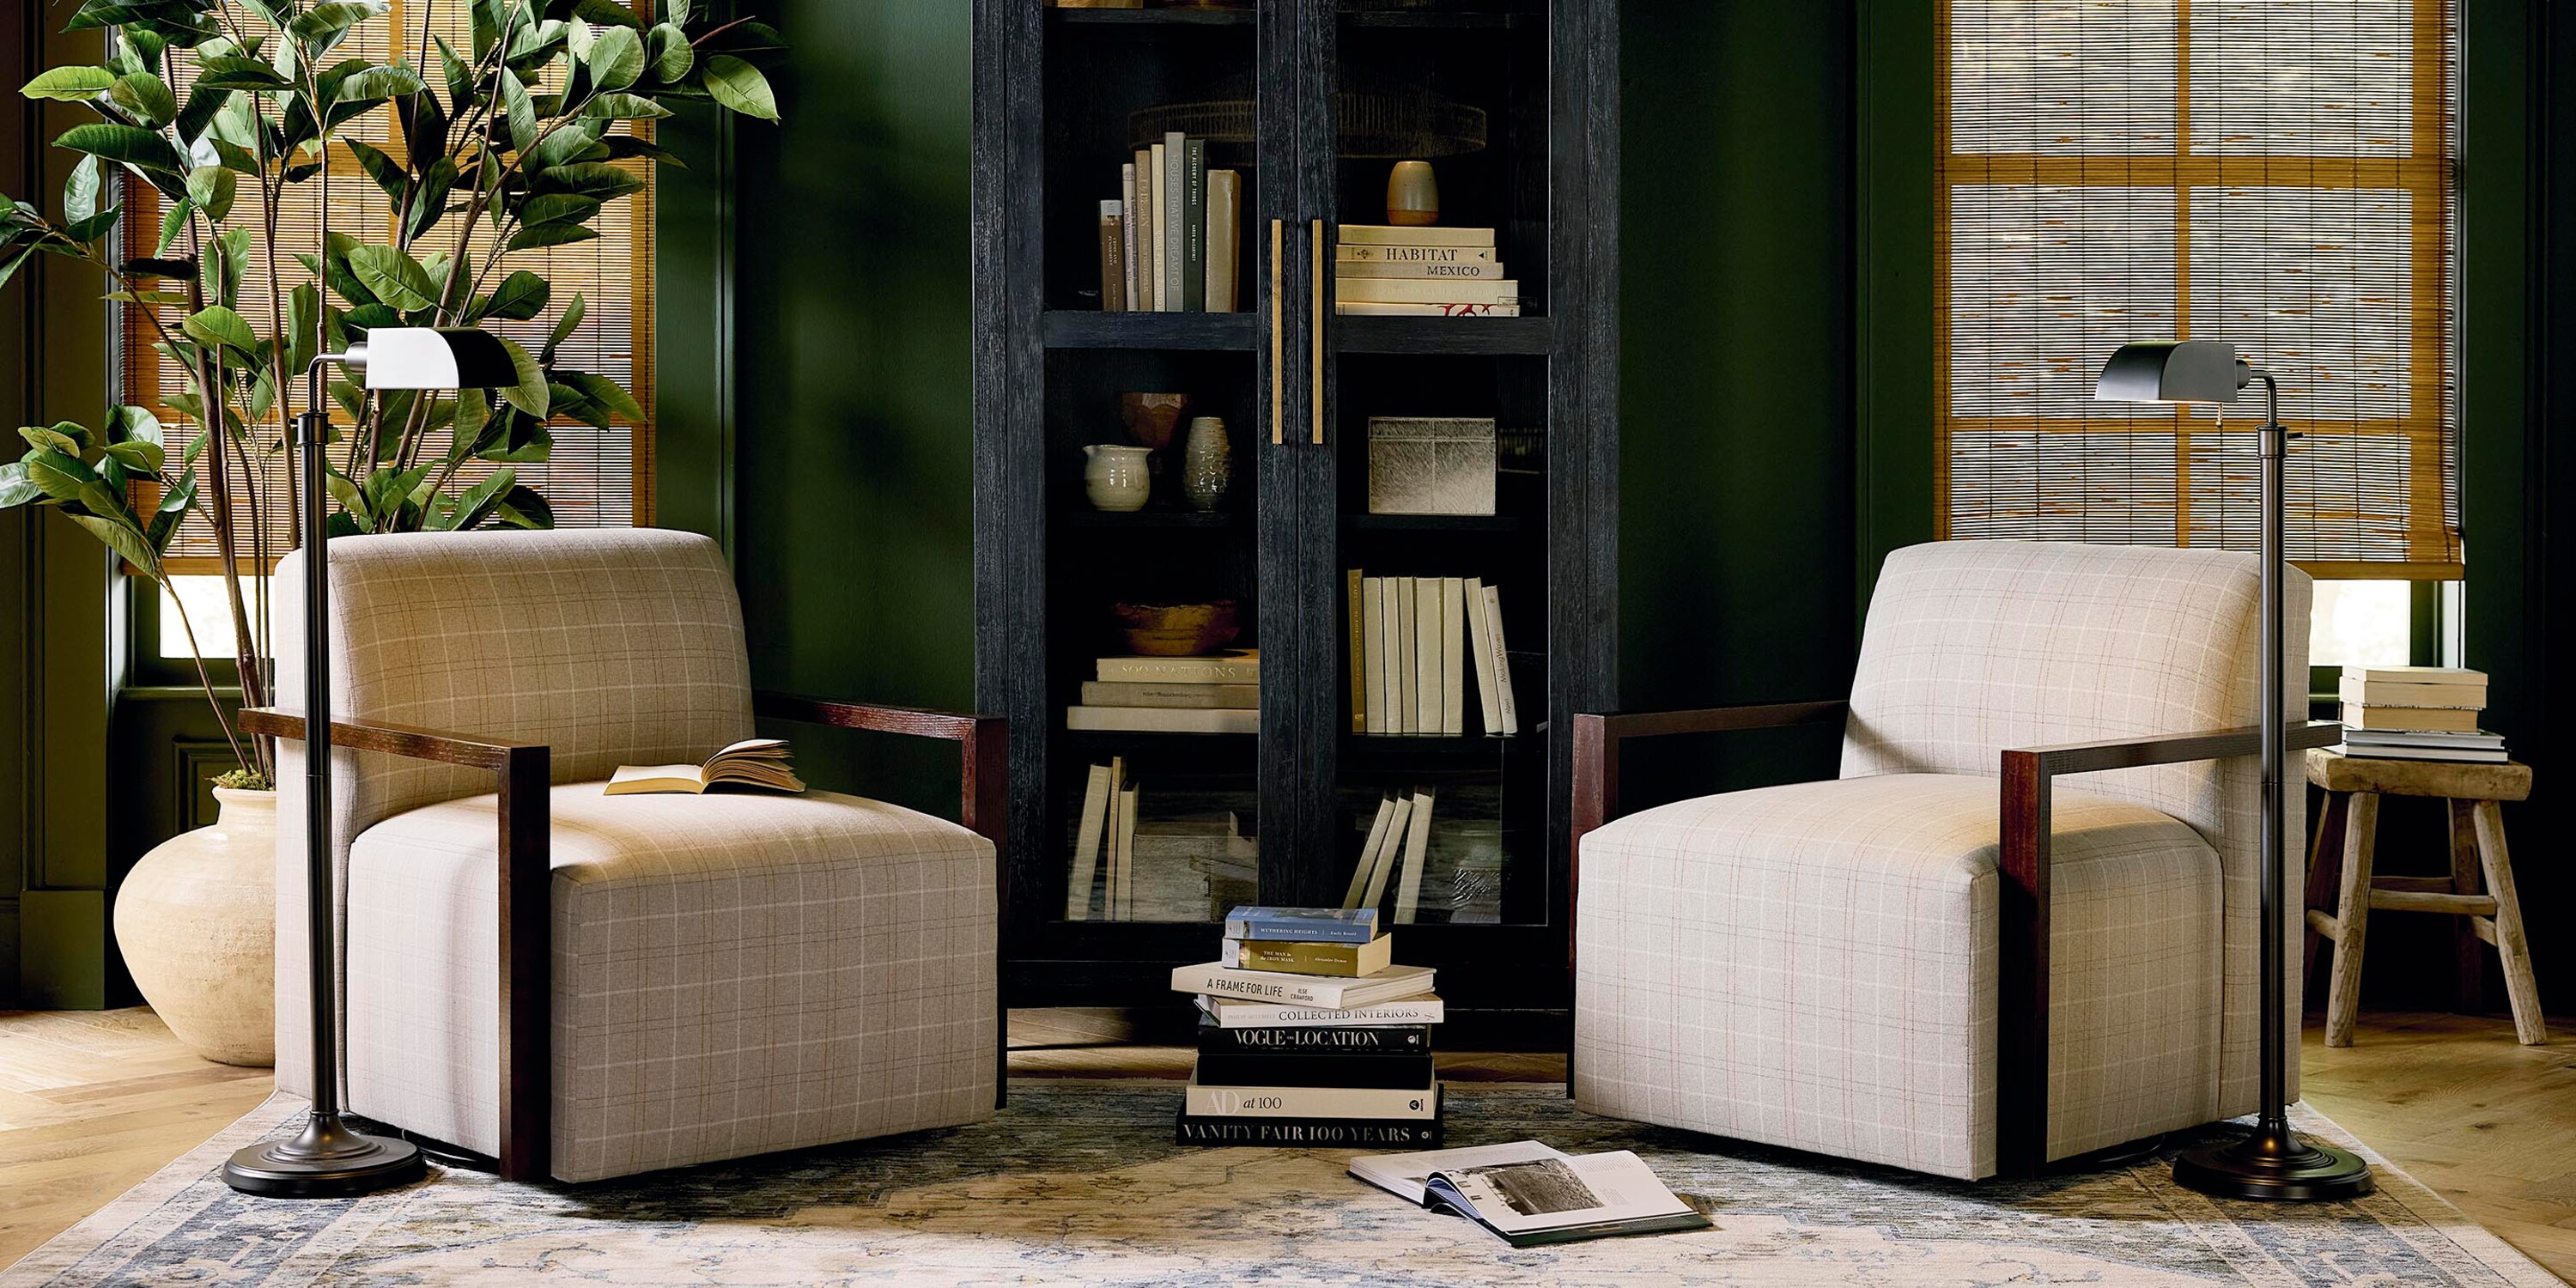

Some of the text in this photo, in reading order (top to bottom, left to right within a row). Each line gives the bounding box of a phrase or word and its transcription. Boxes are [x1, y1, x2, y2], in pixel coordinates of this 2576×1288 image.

[1170, 155, 1179, 292] HOUSES THAT WE DREAMT OF
[1386, 248, 1458, 261] HABITAT
[1426, 265, 1480, 277] MEXICO
[1154, 665, 1236, 679] NATIONS
[1206, 978, 1283, 999] A FRAME FOR LIFE
[1290, 993, 1314, 1003] CRAWFORD
[1279, 1009, 1351, 1022] COLLECTED
[1354, 1007, 1419, 1020] INTERIORS
[1234, 1030, 1285, 1046] VOGUE
[1295, 1030, 1379, 1047] LOCATION
[1204, 1090, 1282, 1115] AD at 100
[1182, 1123, 1410, 1143] VANITY FAIR 100 YEARS
